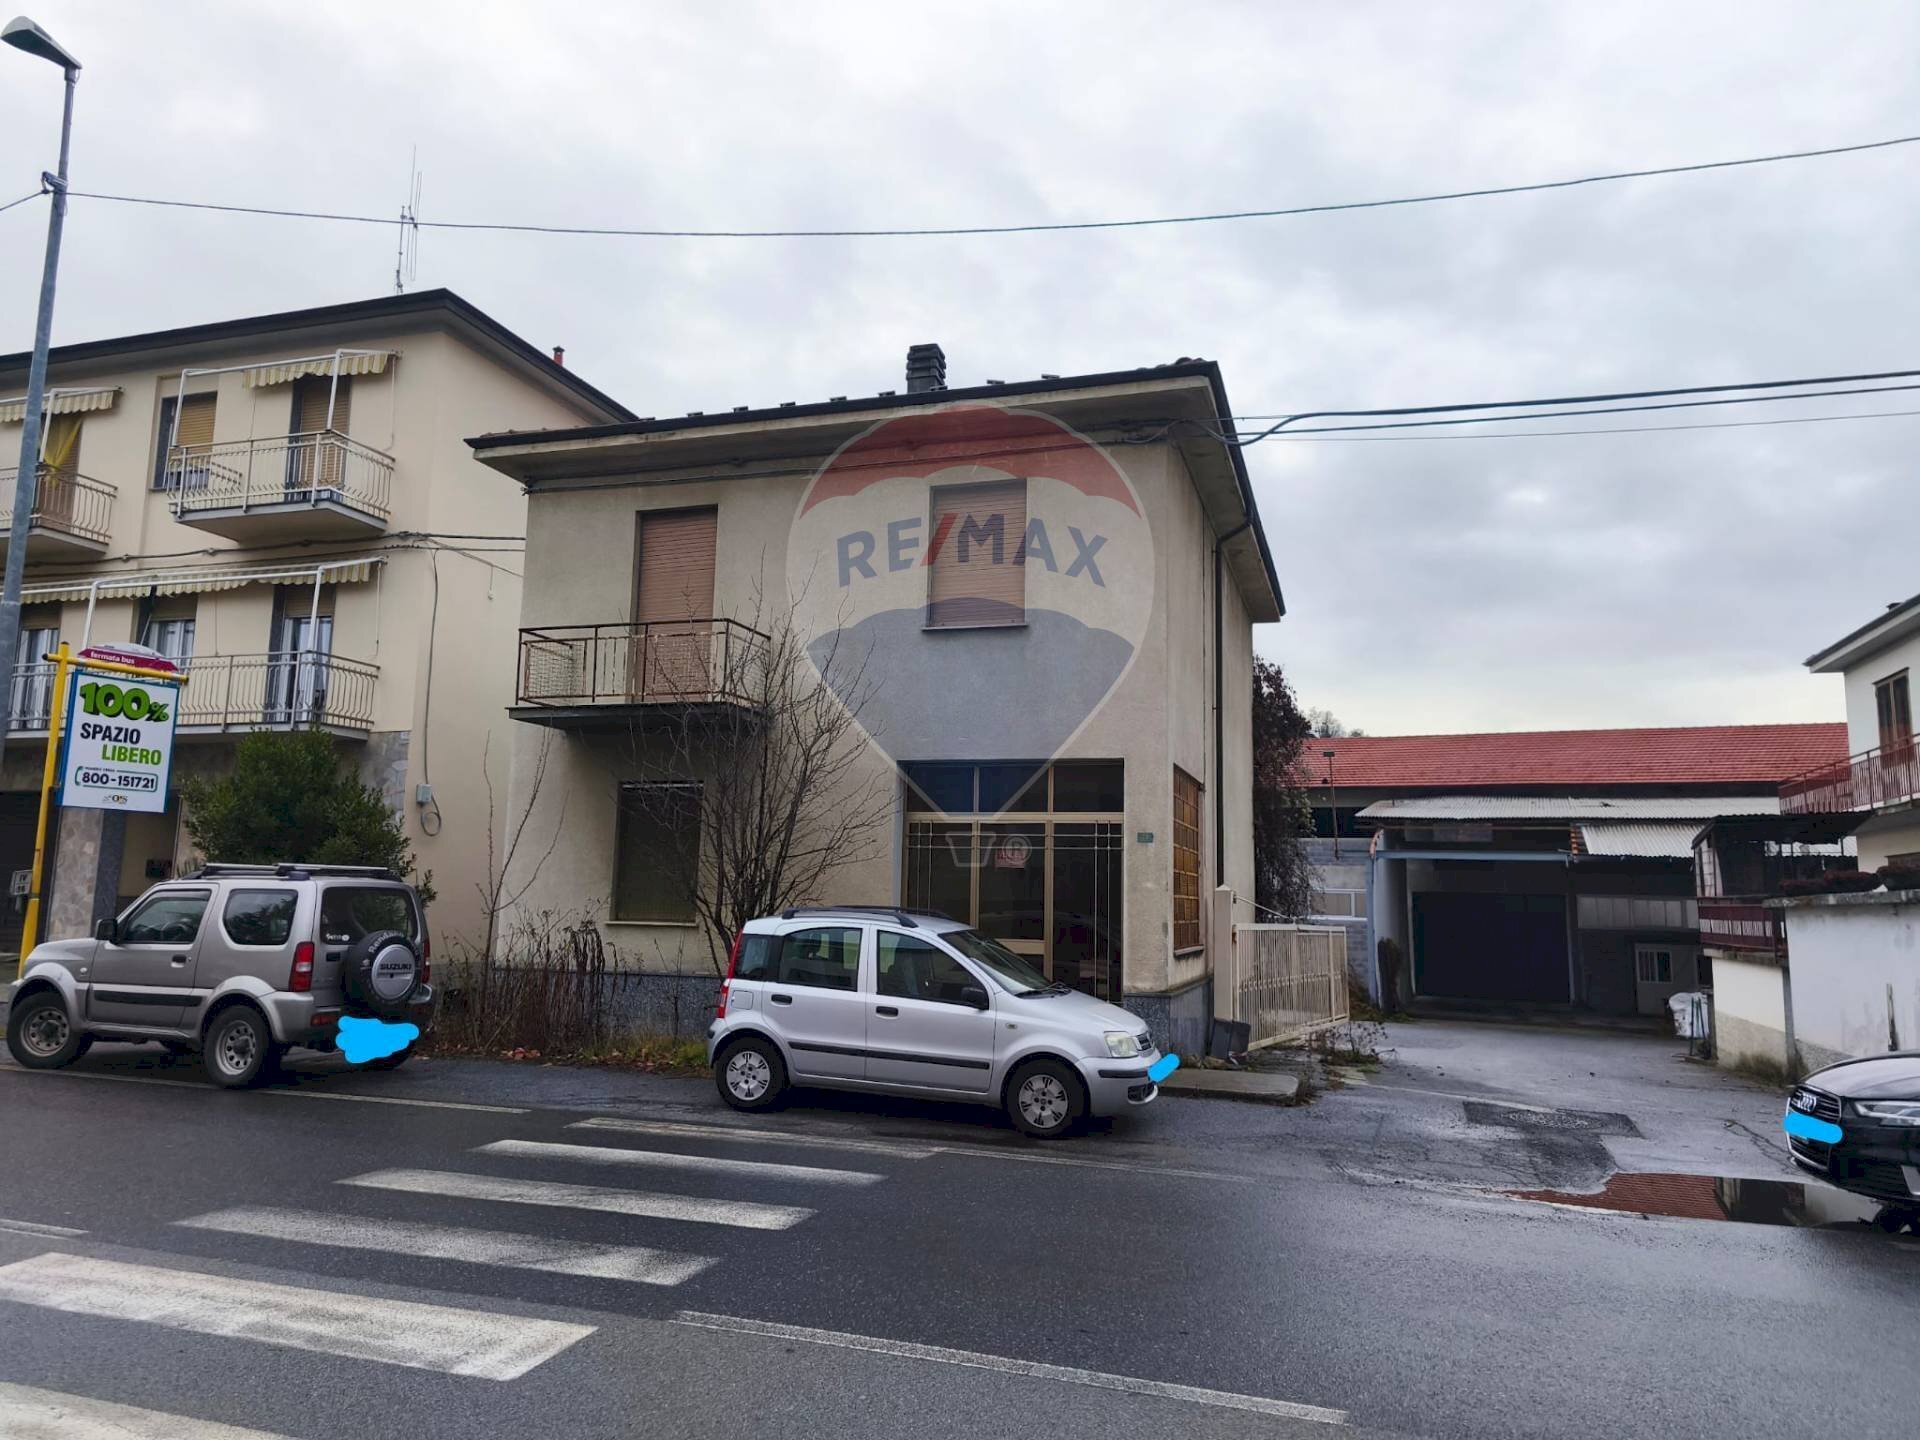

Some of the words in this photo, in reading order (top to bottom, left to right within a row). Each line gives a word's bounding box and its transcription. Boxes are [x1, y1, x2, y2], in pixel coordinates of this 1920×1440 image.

[90, 650, 121, 662] fermata
[121, 655, 135, 665] bus
[79, 682, 170, 723] 100%
[80, 722, 141, 745] SPAZIO
[101, 743, 162, 766] LIBERO
[379, 962, 413, 970] SUZUKI
